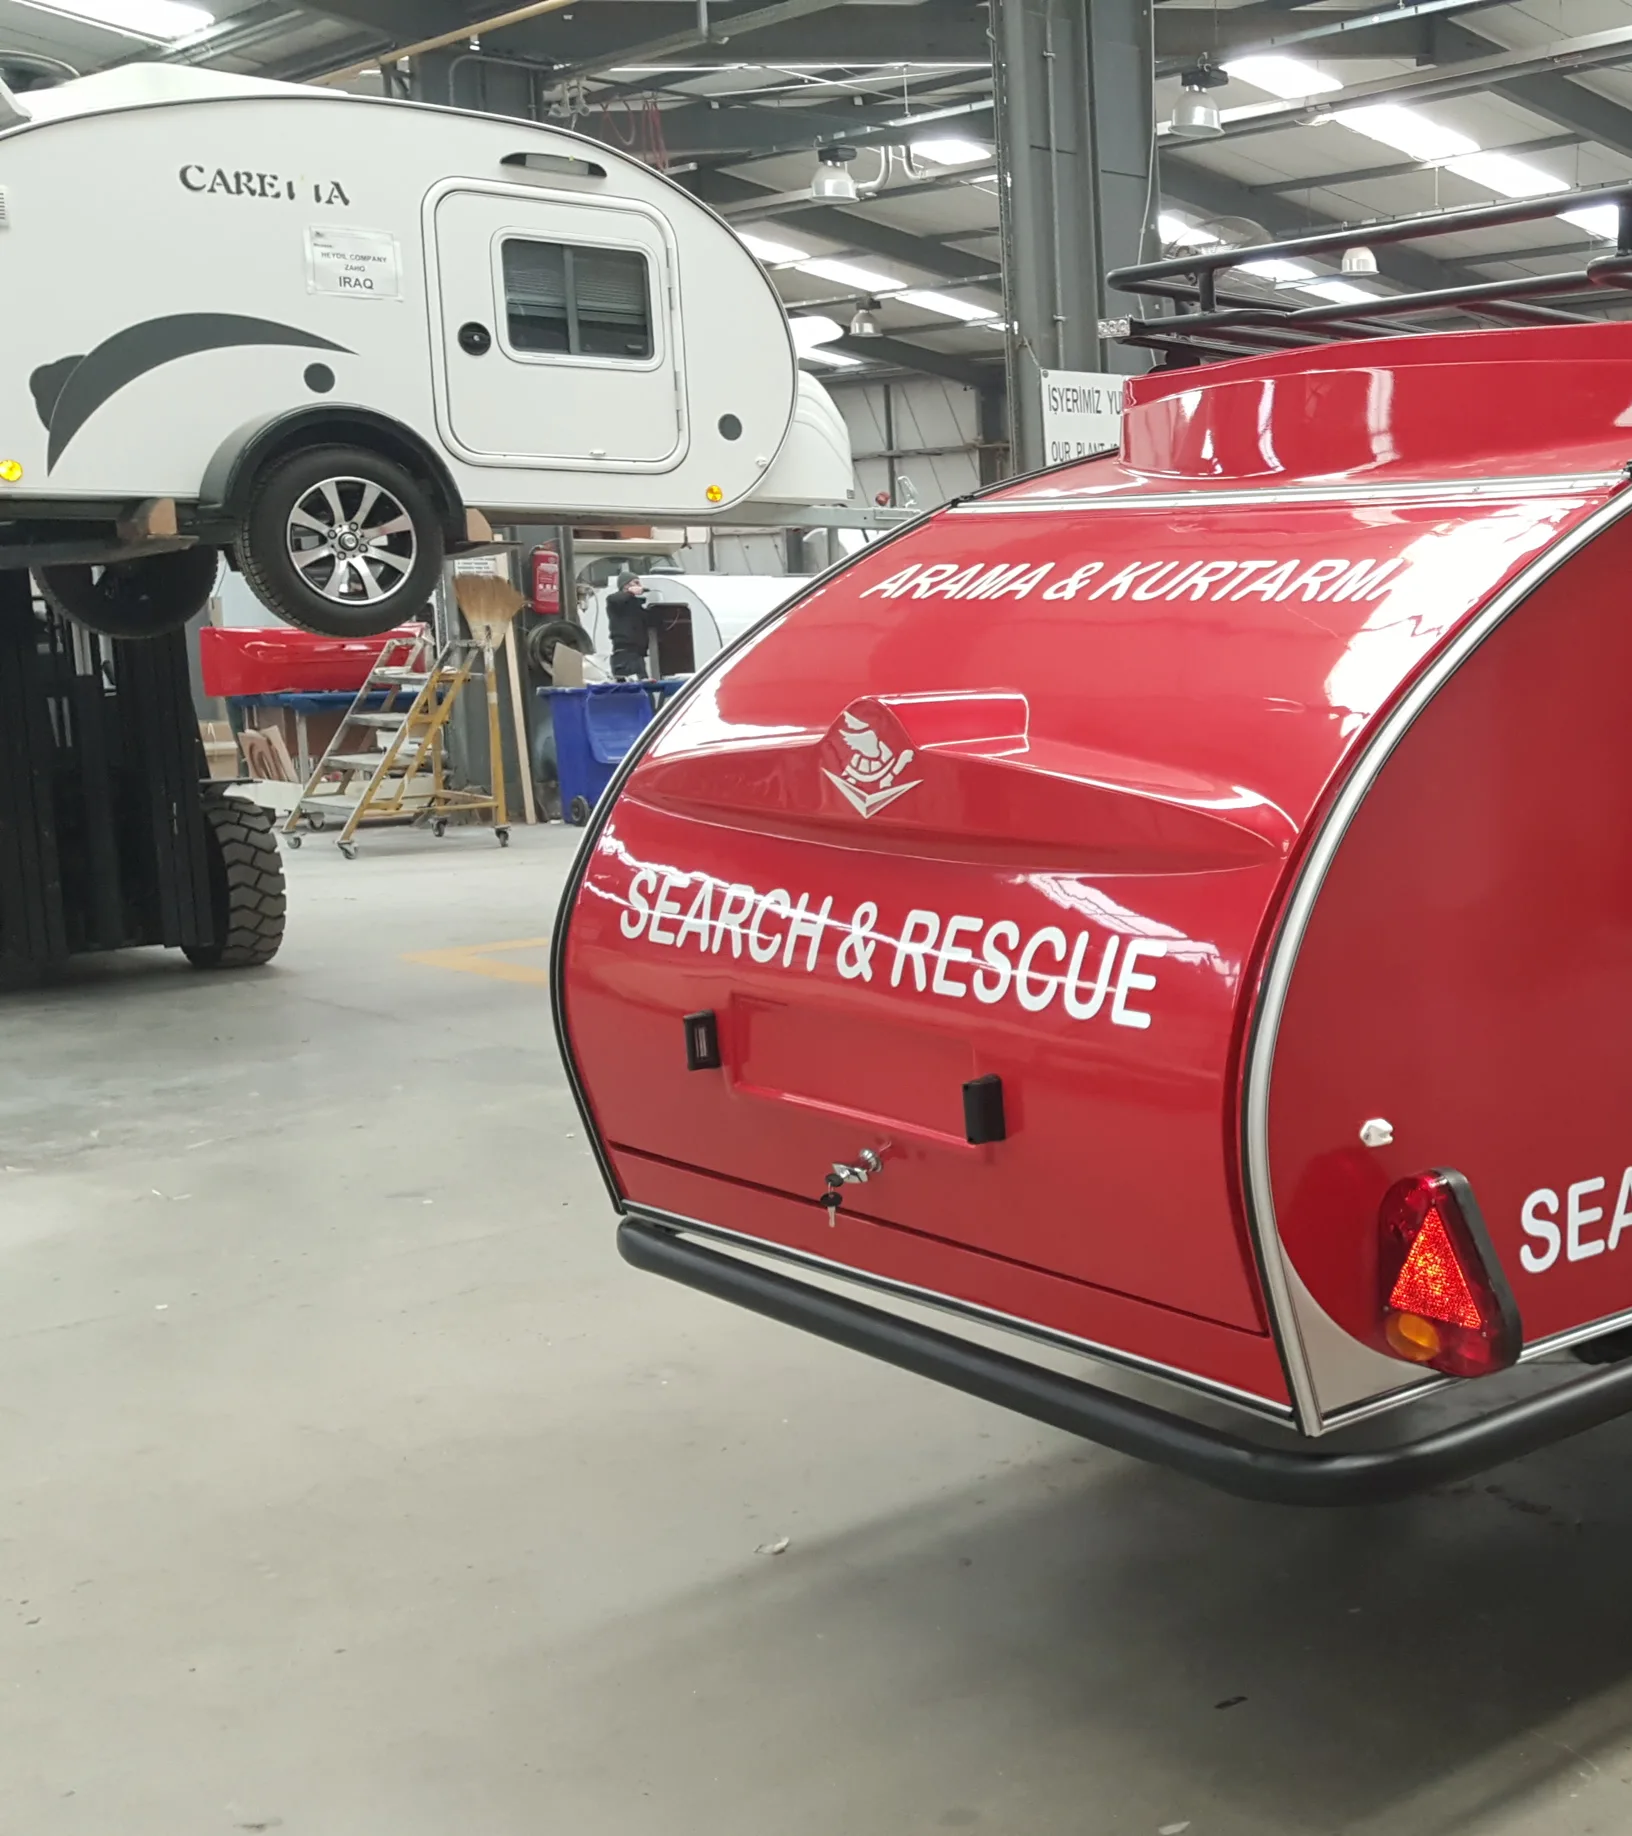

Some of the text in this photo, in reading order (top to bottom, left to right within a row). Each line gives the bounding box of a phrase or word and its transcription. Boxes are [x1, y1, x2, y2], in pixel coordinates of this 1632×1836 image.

[349, 253, 387, 263] COMPANY
[338, 275, 374, 290] IRAQ
[1047, 384, 1103, 415] İŞYERİMİZ
[1051, 441, 1072, 463] OUR
[859, 562, 1055, 600] ARAMA
[1042, 560, 1104, 601] &
[619, 868, 1168, 1029] SEARCH & RESCUE
